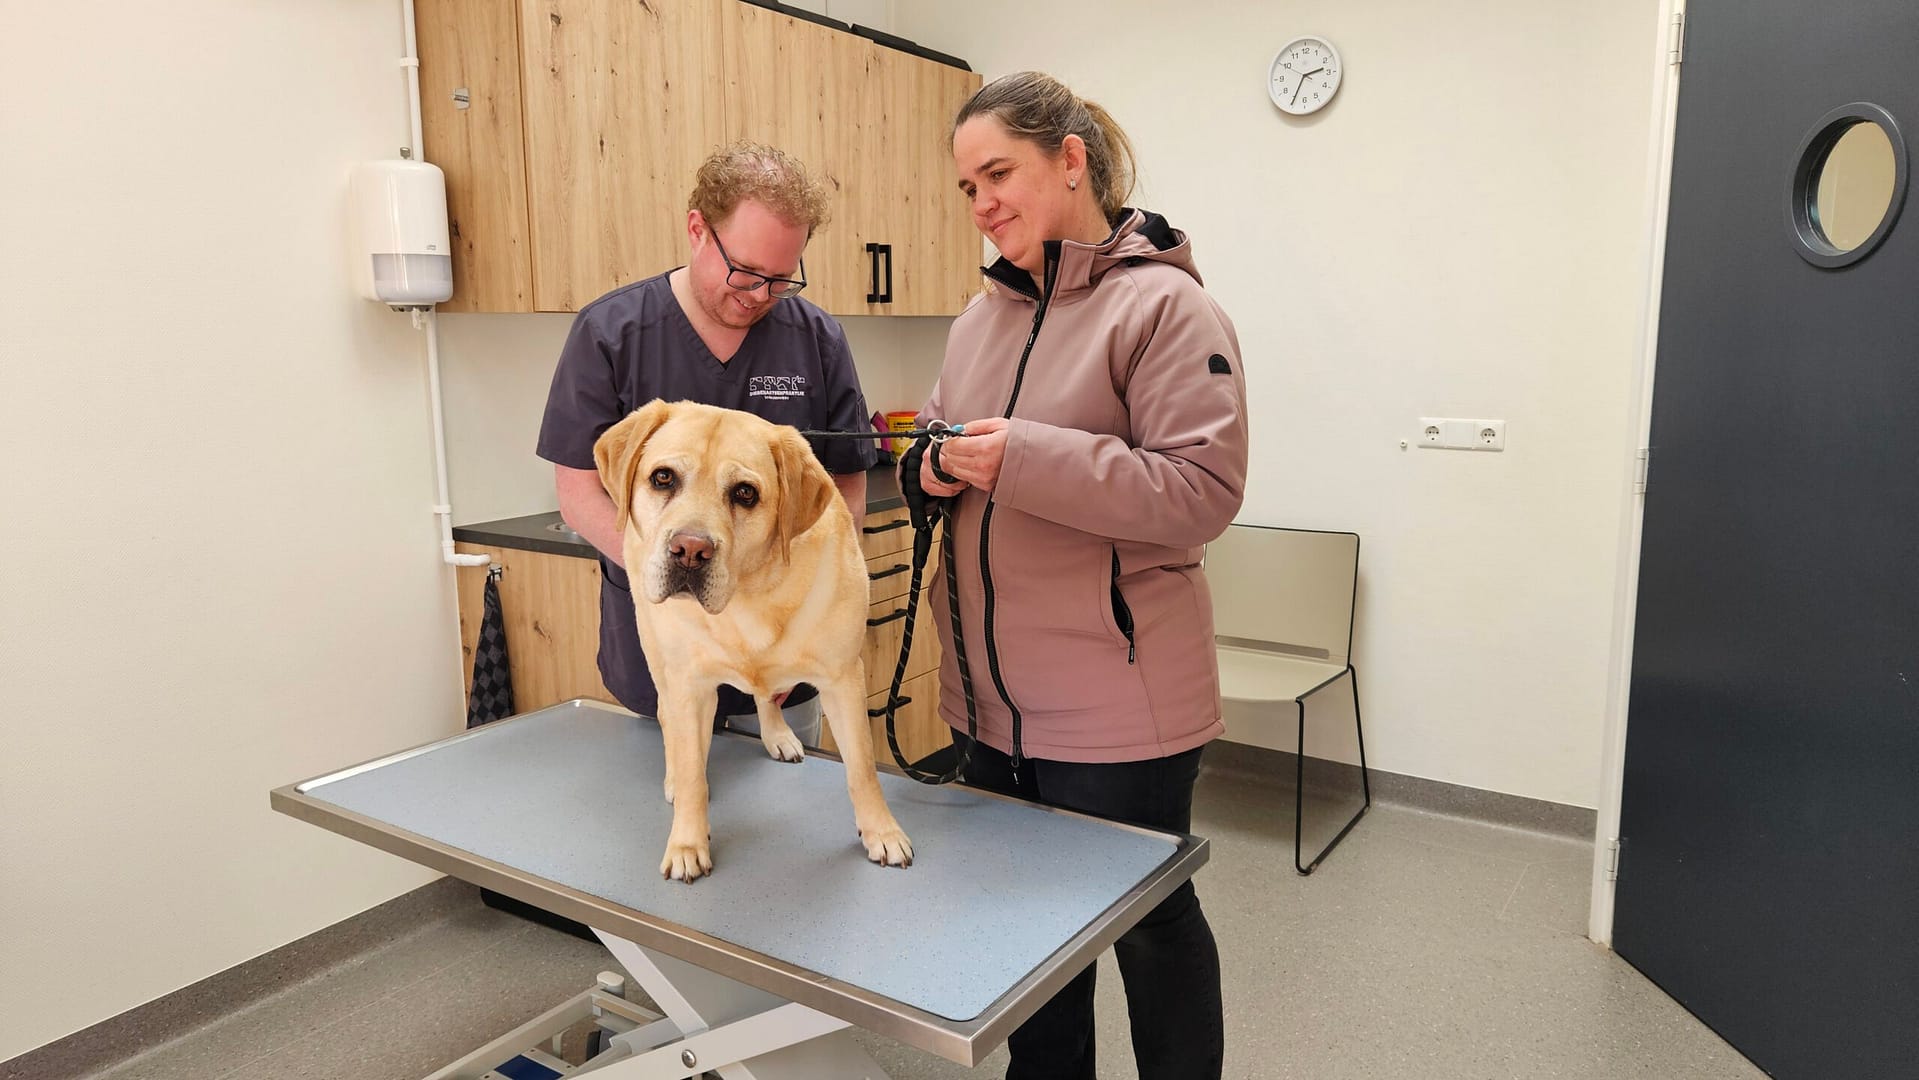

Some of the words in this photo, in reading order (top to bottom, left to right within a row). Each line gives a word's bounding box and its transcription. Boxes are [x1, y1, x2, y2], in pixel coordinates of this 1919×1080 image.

[1301, 47, 1311, 55] 12
[1291, 52, 1299, 60] 11
[1322, 56, 1329, 64] 2
[1283, 62, 1292, 70] 10
[1326, 68, 1332, 76] 3
[1279, 75, 1285, 83] 9
[1322, 81, 1328, 89] 4
[1302, 96, 1308, 104] 6
